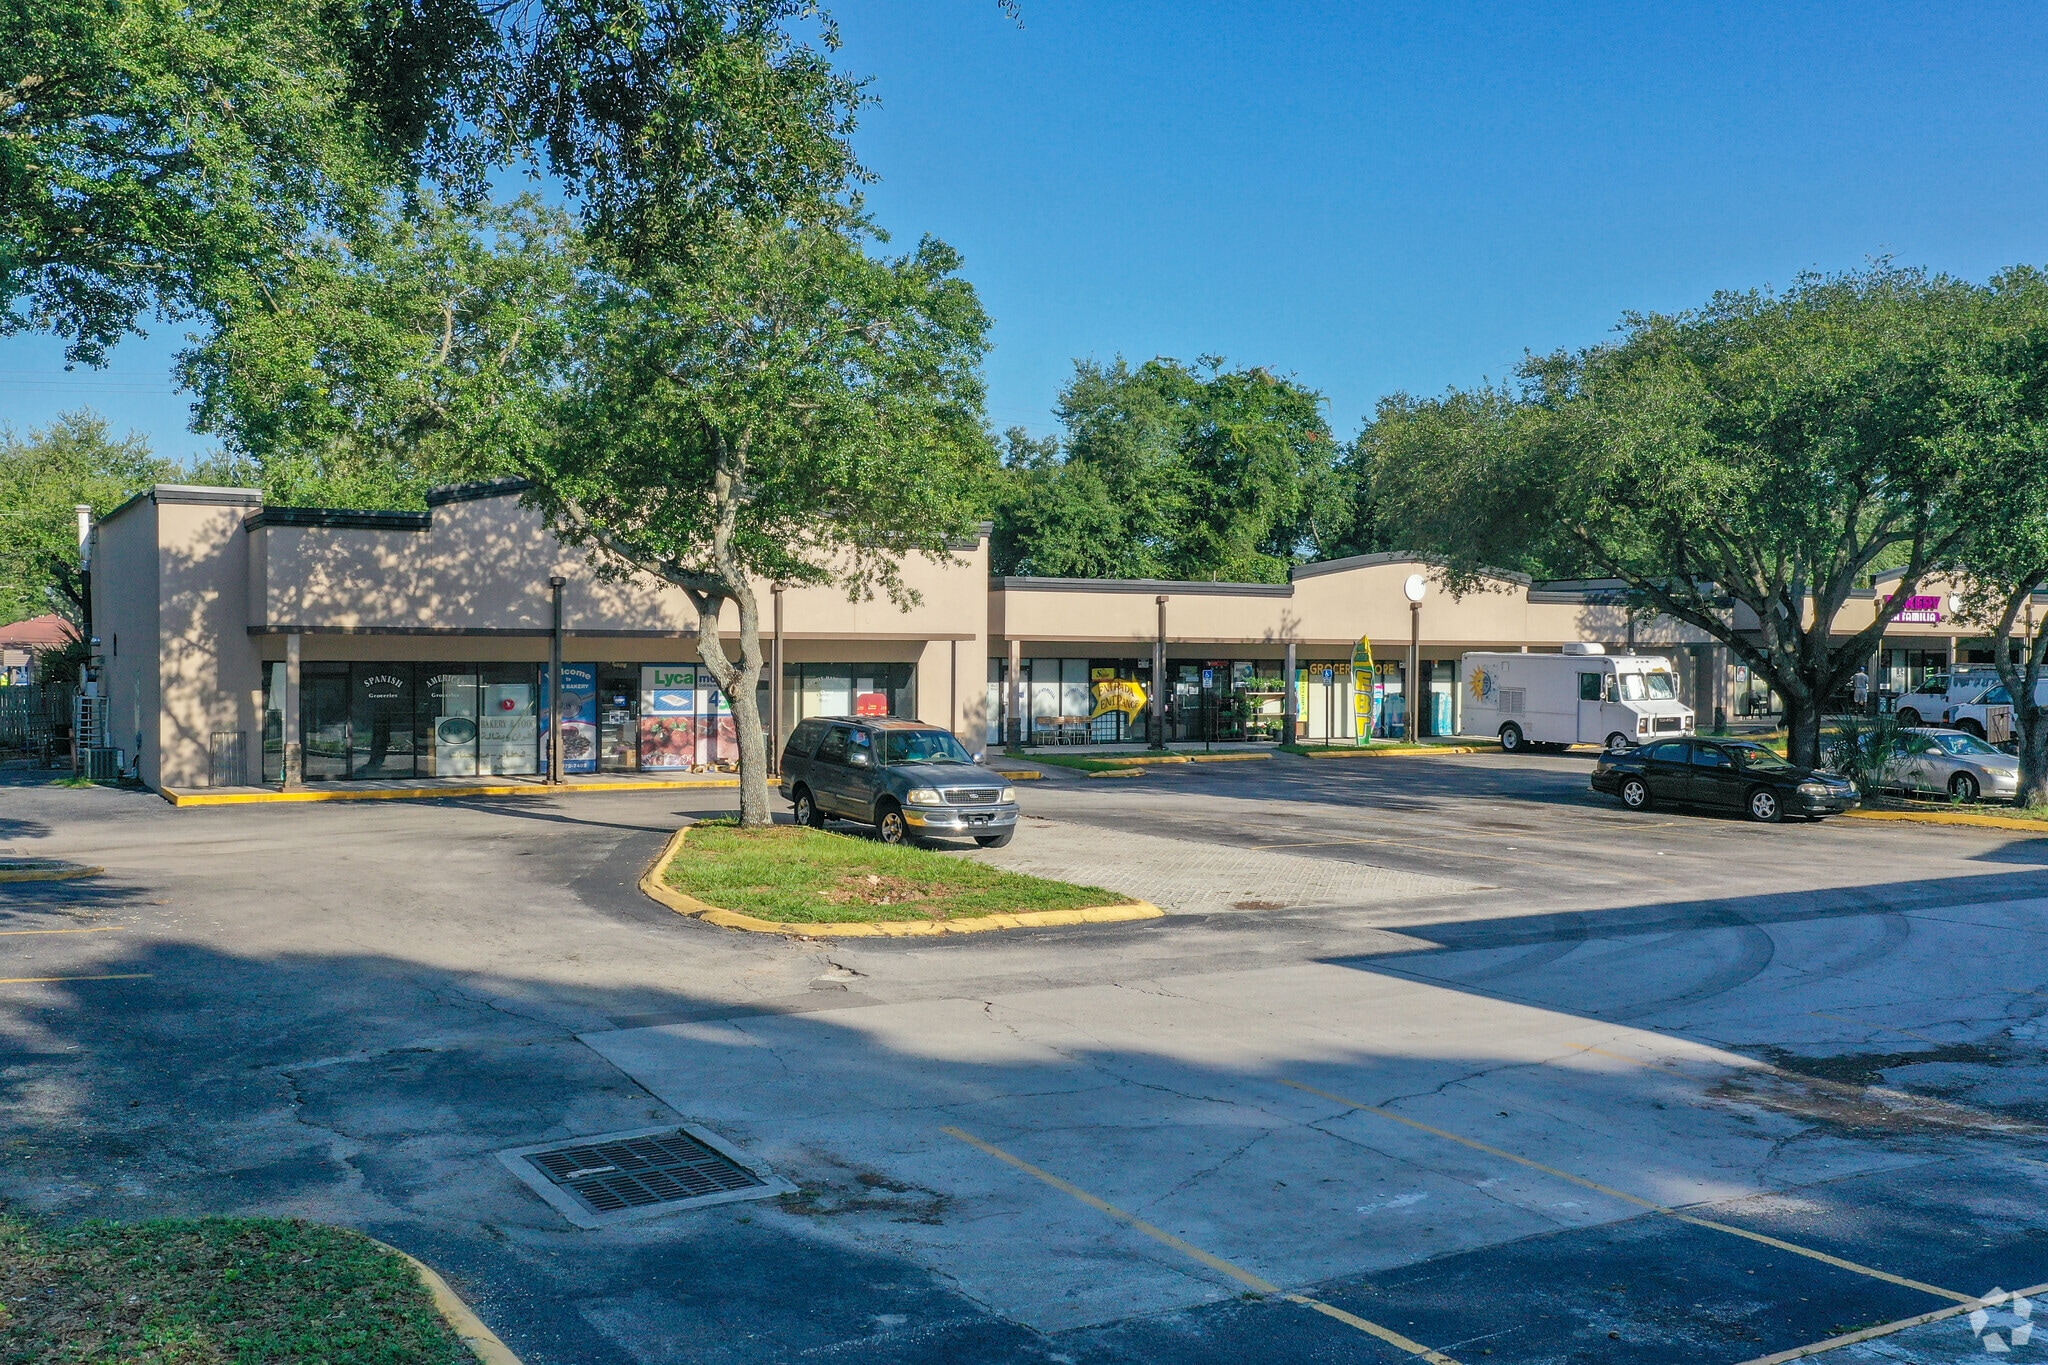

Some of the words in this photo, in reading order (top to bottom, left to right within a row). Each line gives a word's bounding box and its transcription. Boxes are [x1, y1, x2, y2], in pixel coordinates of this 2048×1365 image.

[1902, 612, 1936, 622] FAMILIA
[1310, 663, 1352, 675] GROCER
[364, 675, 403, 688] SPANISH
[655, 670, 693, 687] Lyca
[1098, 682, 1134, 697] ENTRADA
[1101, 695, 1139, 710] ENTRANCE
[1355, 669, 1373, 738] EBT
[480, 720, 506, 728] BAKERY
